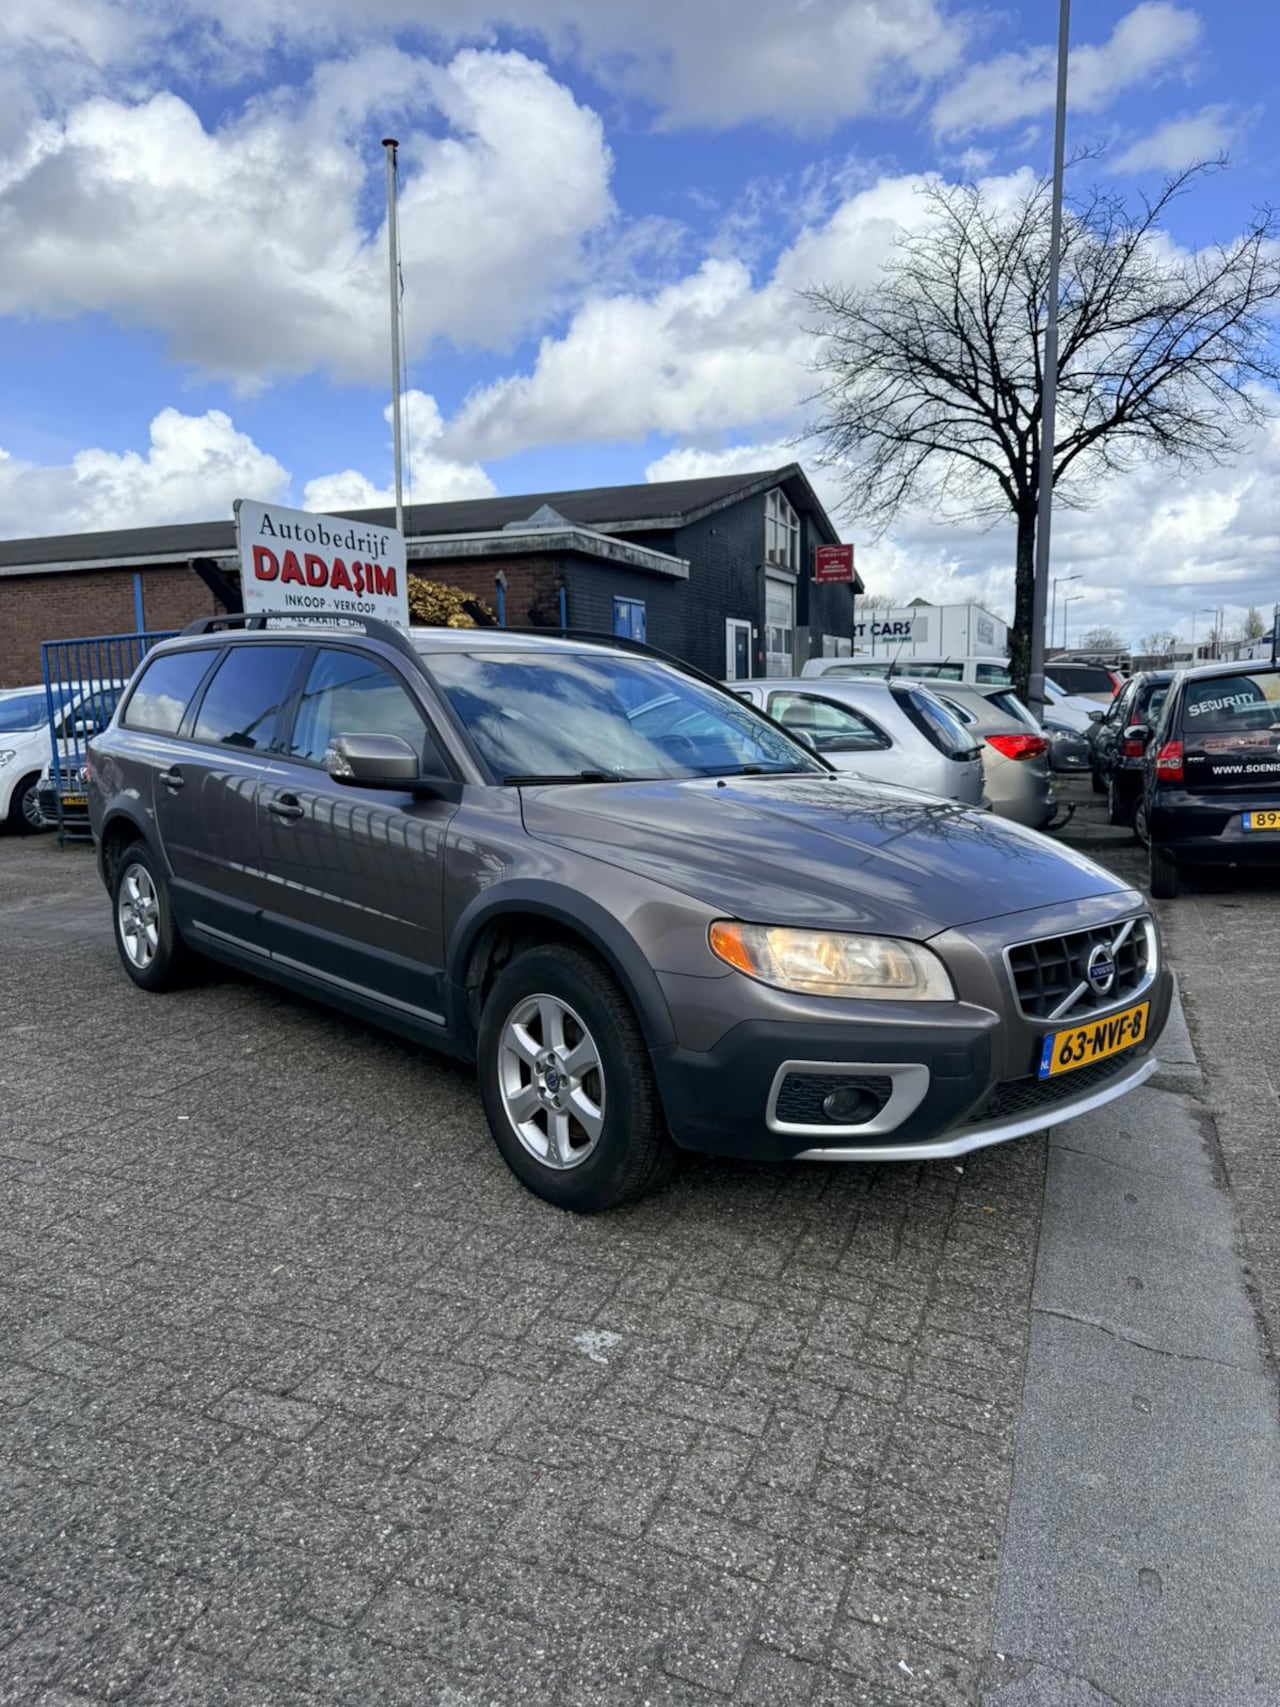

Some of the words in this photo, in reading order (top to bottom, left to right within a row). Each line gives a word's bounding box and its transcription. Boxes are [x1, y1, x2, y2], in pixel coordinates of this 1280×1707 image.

[259, 513, 389, 559] Autobedrijf
[252, 545, 397, 598] DADAŞIM
[285, 594, 325, 609] INKOOP
[334, 600, 376, 614] VERKOOP
[870, 621, 911, 636] CARS
[1188, 692, 1255, 717] SECURITY
[1059, 1011, 1142, 1065] 63-NVF-8
